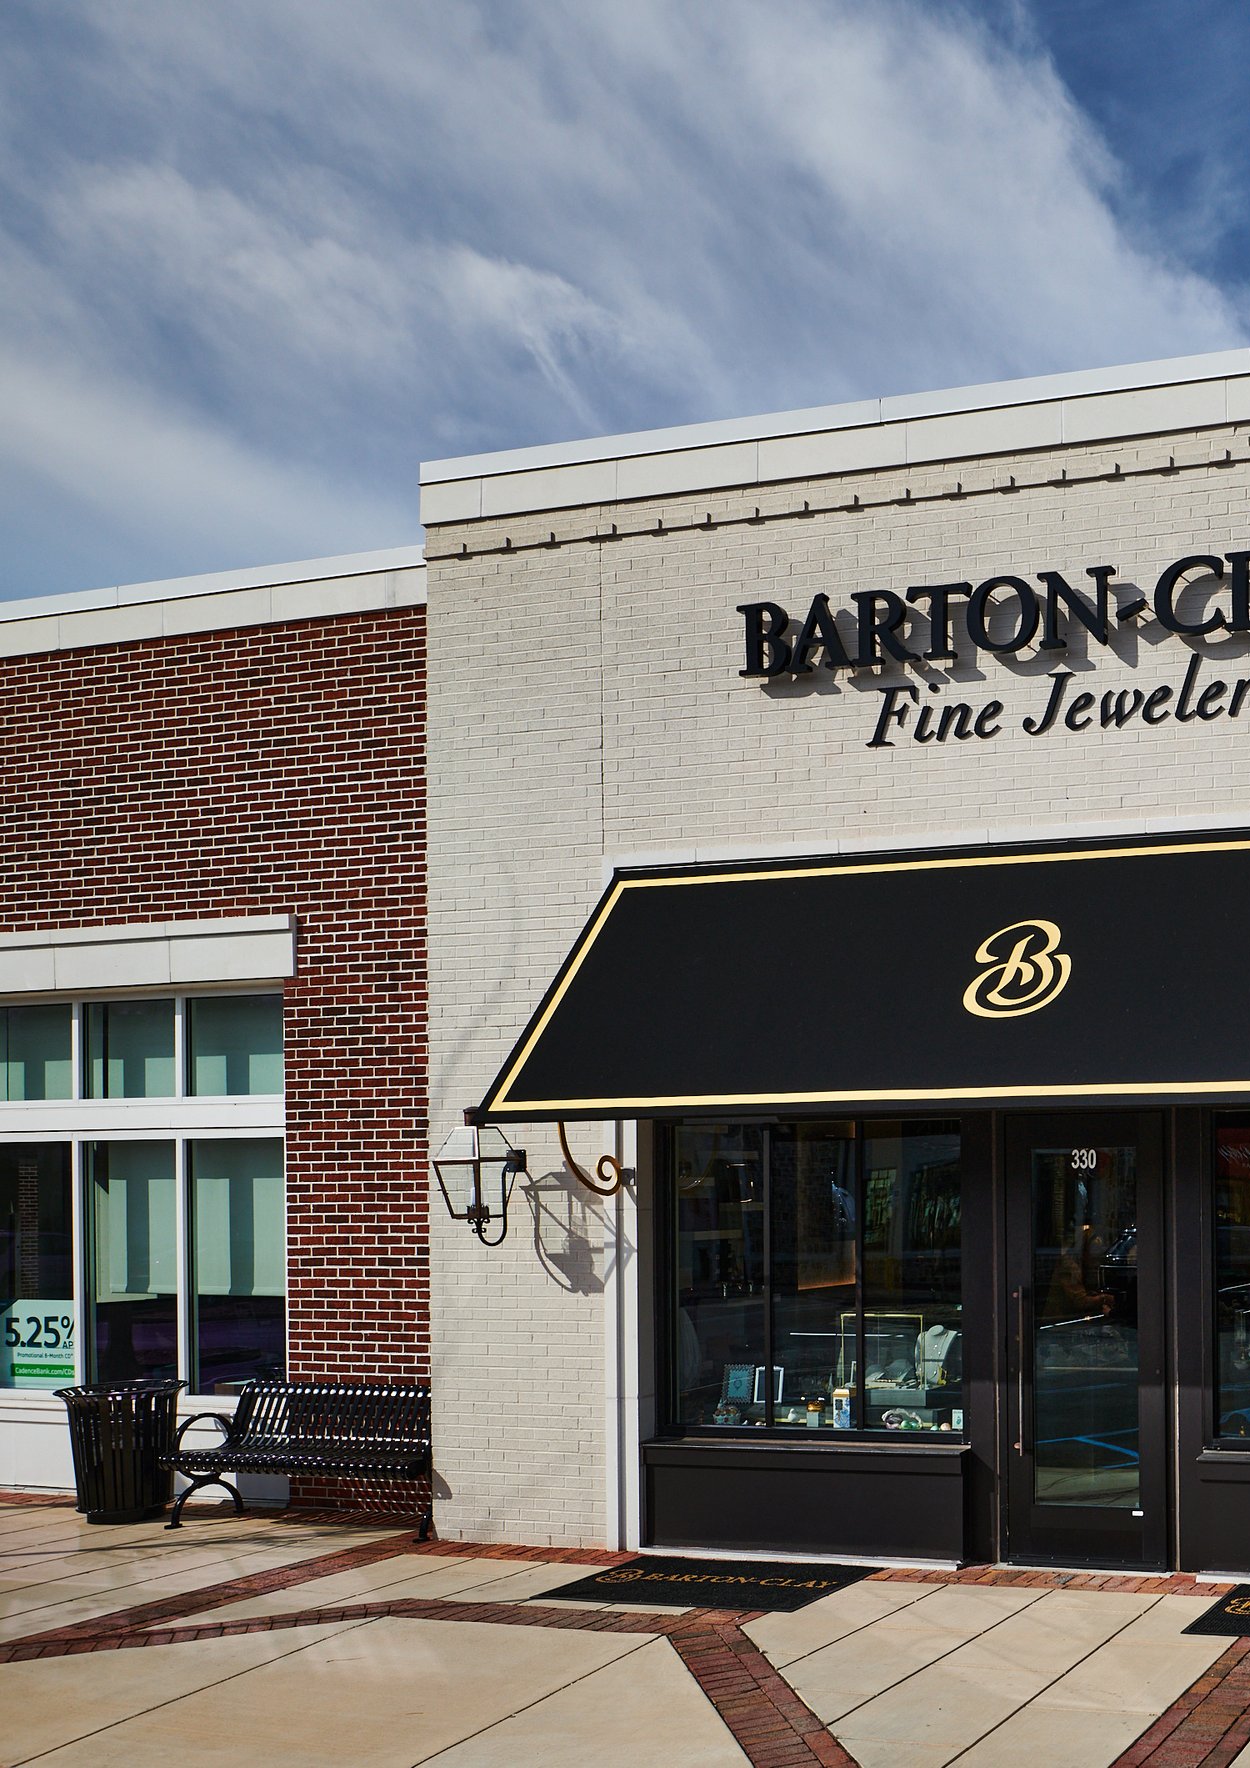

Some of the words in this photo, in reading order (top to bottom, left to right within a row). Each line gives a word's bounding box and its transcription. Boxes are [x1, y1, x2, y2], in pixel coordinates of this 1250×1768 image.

[866, 681, 1003, 748] Fine
[1071, 1149, 1097, 1169] 330
[5, 1315, 74, 1348] 5.25%
[642, 1572, 839, 1589] BARTON-CLAY
